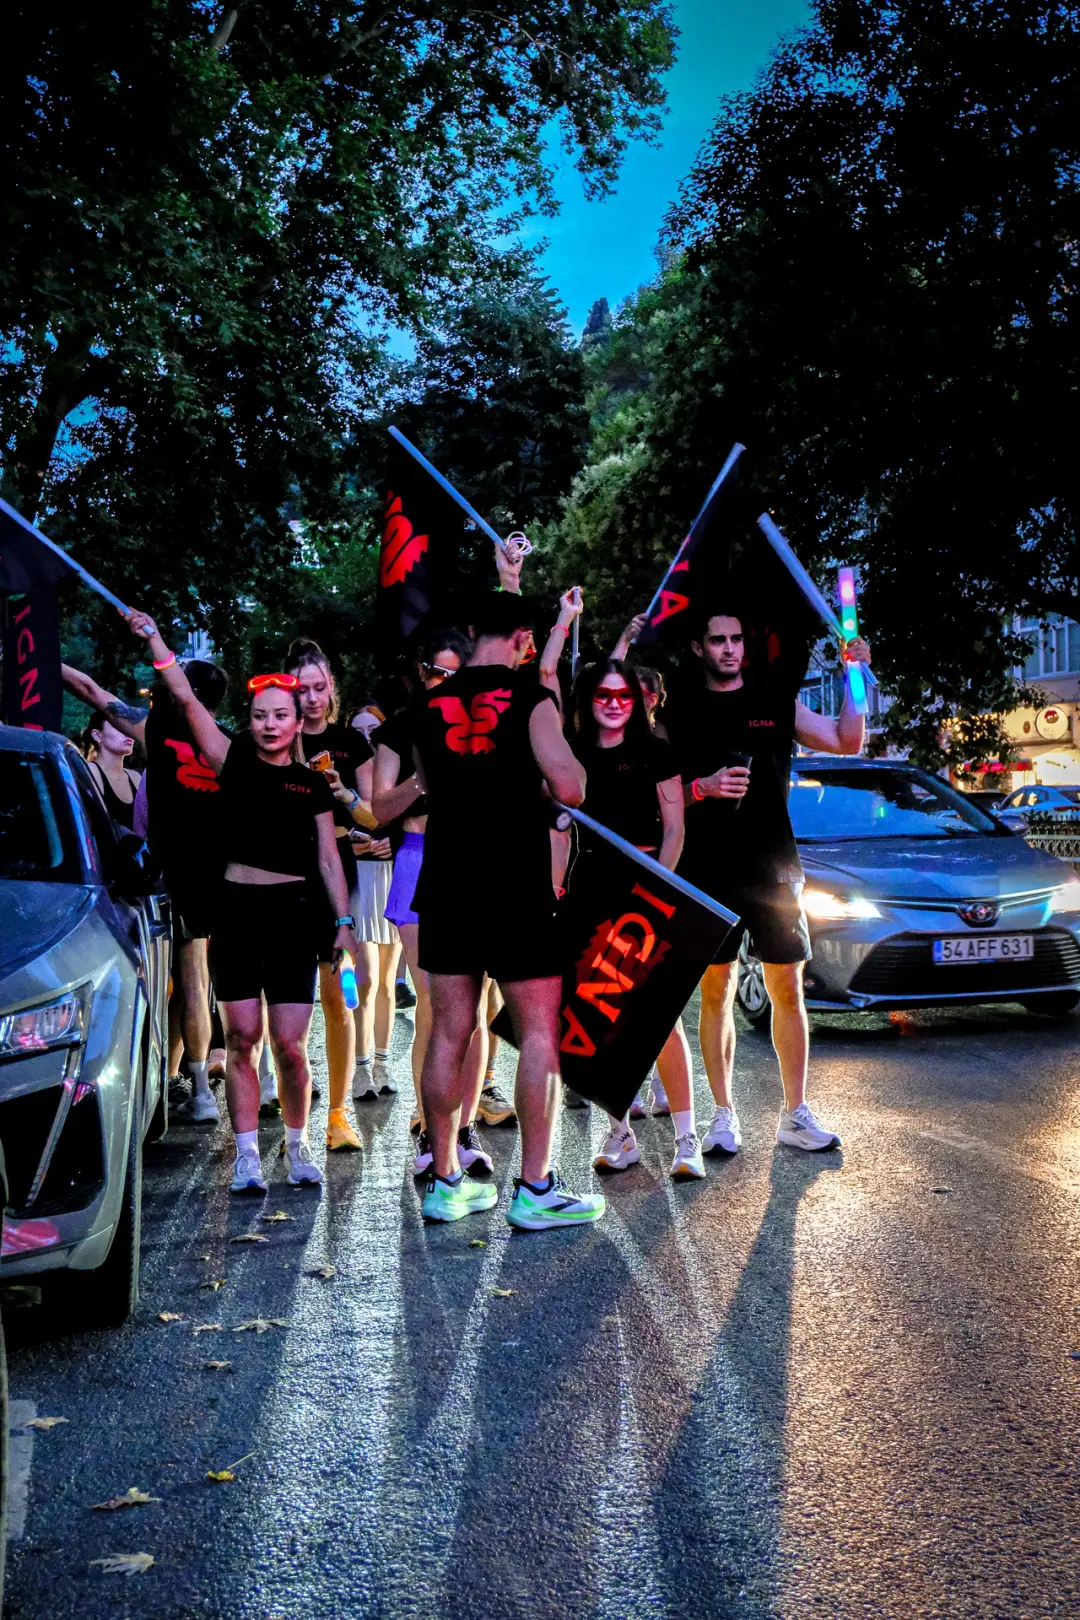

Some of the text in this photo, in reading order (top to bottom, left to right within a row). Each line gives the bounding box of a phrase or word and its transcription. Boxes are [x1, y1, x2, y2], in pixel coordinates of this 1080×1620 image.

[15, 604, 43, 731] IGN
[748, 719, 775, 728] IGNA
[284, 782, 312, 795] IGNA
[943, 937, 1031, 958] 54 AFF 631
[560, 881, 677, 1058] IGNA
